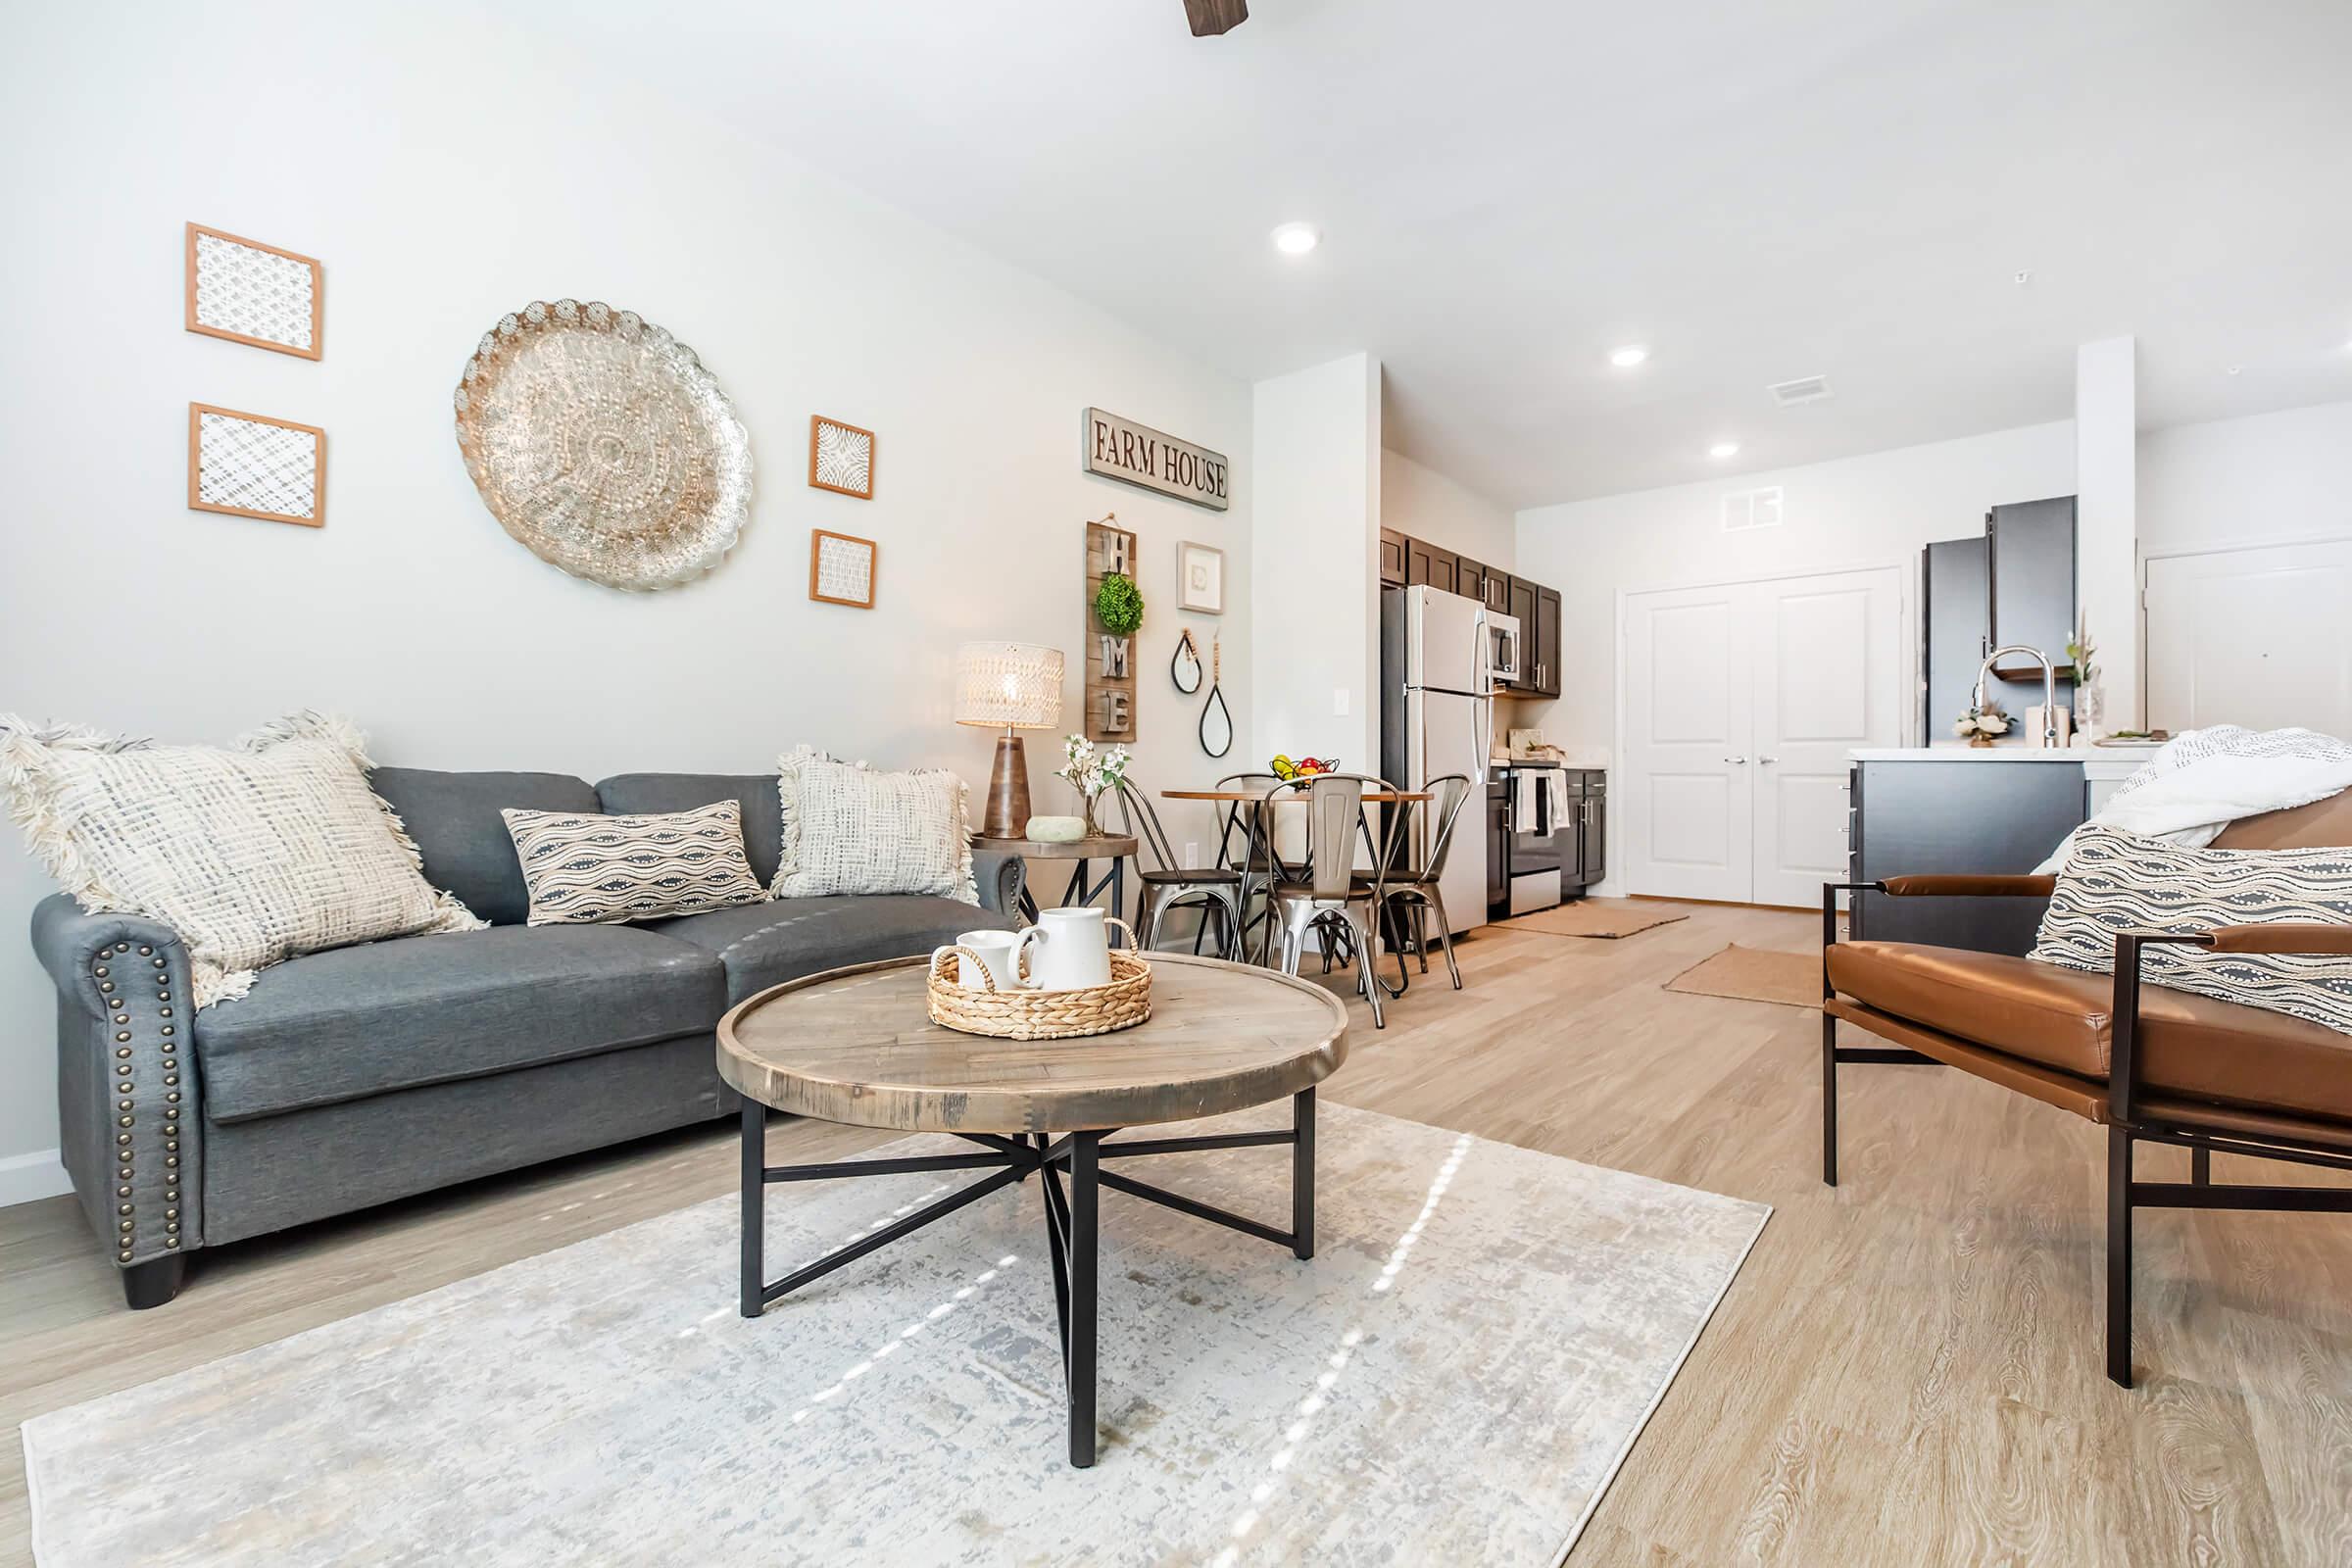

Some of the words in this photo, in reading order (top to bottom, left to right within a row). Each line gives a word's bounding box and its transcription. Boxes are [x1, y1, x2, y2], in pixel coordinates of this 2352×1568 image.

[1094, 419, 1156, 477] FARM
[1162, 444, 1227, 499] HOUSE
[1099, 530, 1138, 733] HME
